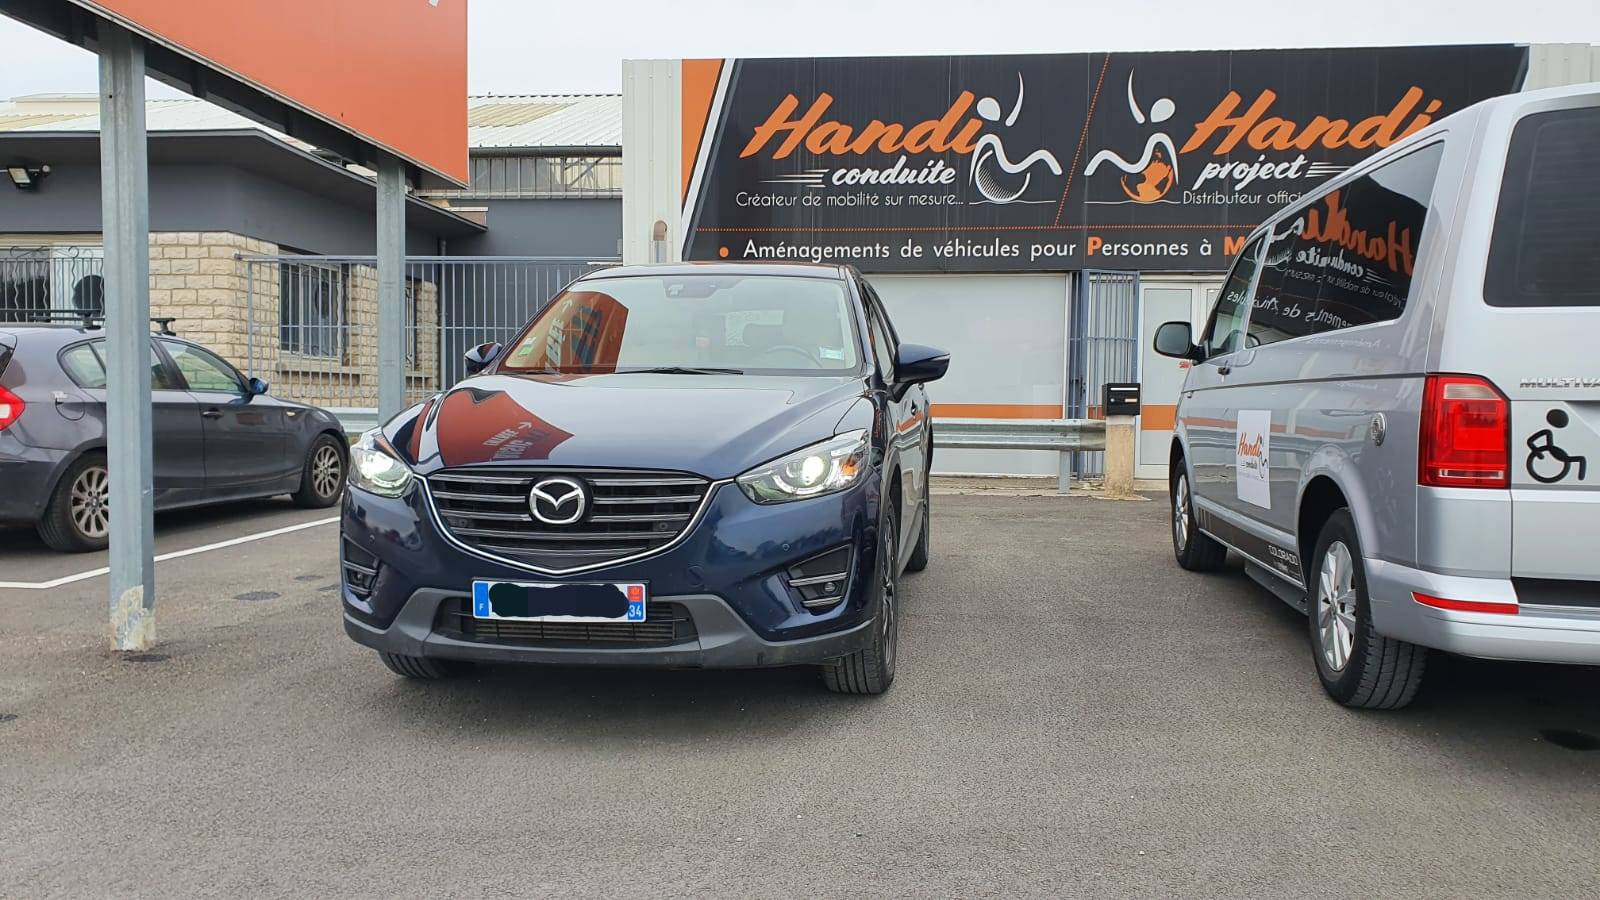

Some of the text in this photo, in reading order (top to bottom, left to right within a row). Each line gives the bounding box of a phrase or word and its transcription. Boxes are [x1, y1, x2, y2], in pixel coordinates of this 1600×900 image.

[740, 90, 983, 160] Handi
[831, 154, 956, 186] conduite
[1192, 154, 1308, 191] project
[736, 191, 798, 207] Créateur
[803, 191, 822, 206] de
[826, 191, 880, 207] mobilité
[885, 196, 904, 206] sur
[1183, 189, 1262, 205] Distributeur
[743, 239, 890, 263] Aménagements
[900, 238, 923, 258] de
[932, 238, 1020, 258] véhicules
[1031, 243, 1077, 262] pour
[1087, 235, 1189, 257] Personnes
[1200, 238, 1212, 256] à
[479, 603, 485, 611] F
[628, 604, 642, 617] 34
